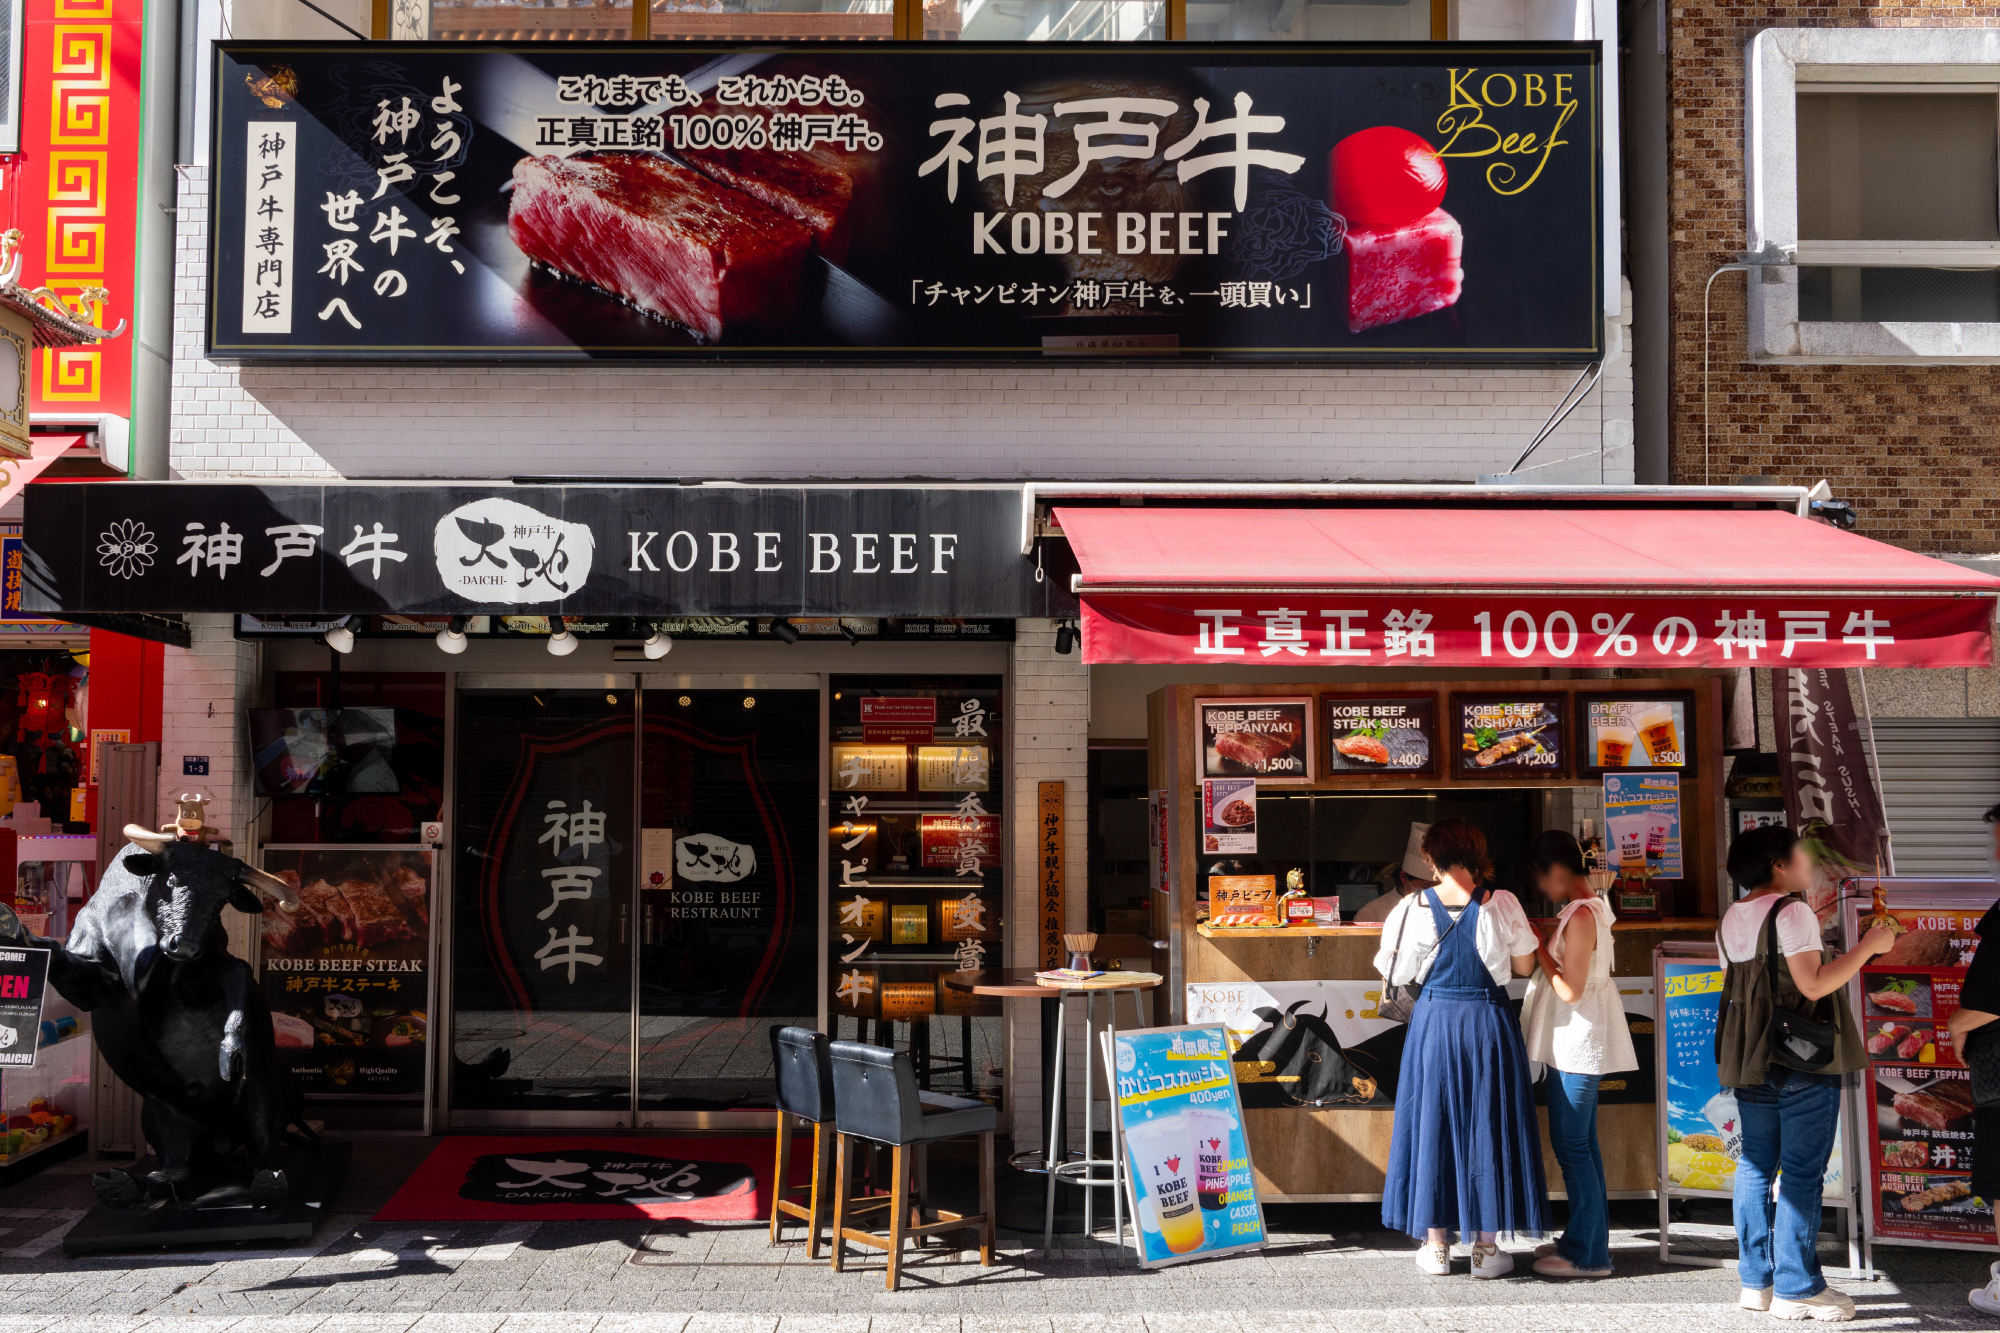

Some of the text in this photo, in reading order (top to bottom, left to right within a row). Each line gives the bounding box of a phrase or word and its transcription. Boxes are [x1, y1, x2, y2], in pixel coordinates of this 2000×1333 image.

[557, 75, 866, 107] これまでも、これからも。
[1446, 68, 1573, 106] KOBE
[918, 91, 1306, 213] 神戸牛
[1426, 99, 1578, 195] Beef
[424, 76, 466, 274] ようこそ、
[370, 95, 420, 298] 神戸牛の
[253, 131, 285, 319] 神戸牛専門店
[973, 212, 1232, 255] KOBE BEEF
[317, 190, 365, 331] 世界へ
[910, 279, 1313, 310] 「チャンピオン神戸牛を、一頭買い」
[513, 525, 556, 540] 神戸牛
[176, 521, 408, 581] 神戸牛
[627, 530, 959, 575] KOBE BEEF
[261, 621, 285, 630] KOBE
[289, 621, 312, 630] BEEF
[382, 621, 448, 630] Steamed KOBE
[508, 622, 533, 632] KOBE
[904, 623, 990, 633] KOBE BEEF STEAK
[1207, 710, 1281, 721] KOBE BEEF
[1333, 706, 1406, 717] KOBE BEEF
[1464, 705, 1538, 716] KOBE BEEF
[1590, 704, 1634, 714] DRAFT
[1208, 722, 1293, 734] TEPPANYAKI
[1333, 718, 1420, 730] STEAK SUSHI
[1464, 717, 1538, 729] KUSHIYAKI
[1591, 716, 1627, 727] BEER
[1651, 736, 1672, 747] KOBE
[1653, 742, 1672, 753] BEEF
[1515, 752, 1556, 767] ¥1,200
[1604, 753, 1624, 761] KOBE
[1652, 751, 1682, 764] ¥500
[189, 765, 204, 773] 1-3
[835, 756, 873, 1009] チャンピオン牛
[534, 799, 607, 985] 神戸牛
[670, 891, 761, 904] KOBE BEEF
[1215, 889, 1272, 902] 神戸ビーフ
[670, 907, 761, 919] RESTRAUNT
[1917, 916, 1957, 931] KOBE
[0, 951, 26, 962] COME!
[266, 958, 423, 973] KOBE BEEF STEAK
[0, 974, 30, 999] EN
[285, 975, 402, 993] 神戸牛ステーキ
[1933, 983, 1960, 992] 神戸牛
[1202, 989, 1245, 1003] KOBE
[1171, 1039, 1223, 1058] 期間限定
[1676, 1039, 1706, 1048] オレンジ
[290, 1066, 323, 1074] Authentic
[1878, 1067, 1970, 1081] KOBE BEEF TEPPAN
[1118, 1066, 1227, 1099] かじつスカッシュ
[1189, 1089, 1231, 1105] 400yen
[1902, 1128, 1930, 1138] 神戸牛
[1199, 1140, 1204, 1149] I
[1198, 1154, 1222, 1164] KOBE
[1929, 1145, 1957, 1170] 丼
[602, 1161, 673, 1171] 神戸牛
[1153, 1165, 1161, 1176] I
[1217, 1157, 1248, 1173] LEMON
[1205, 1172, 1251, 1191] PINEAPPLE
[1881, 1173, 1925, 1184] KOBE BEEF
[1156, 1177, 1188, 1195] KOBE
[1881, 1182, 1925, 1192] KUSHIYAKI
[1160, 1190, 1190, 1208] BEEF
[1218, 1188, 1254, 1205] ORANGE
[1229, 1204, 1257, 1219] CASSIS
[1942, 1205, 1964, 1214] 神戸牛
[1232, 1220, 1261, 1236] PEACH
